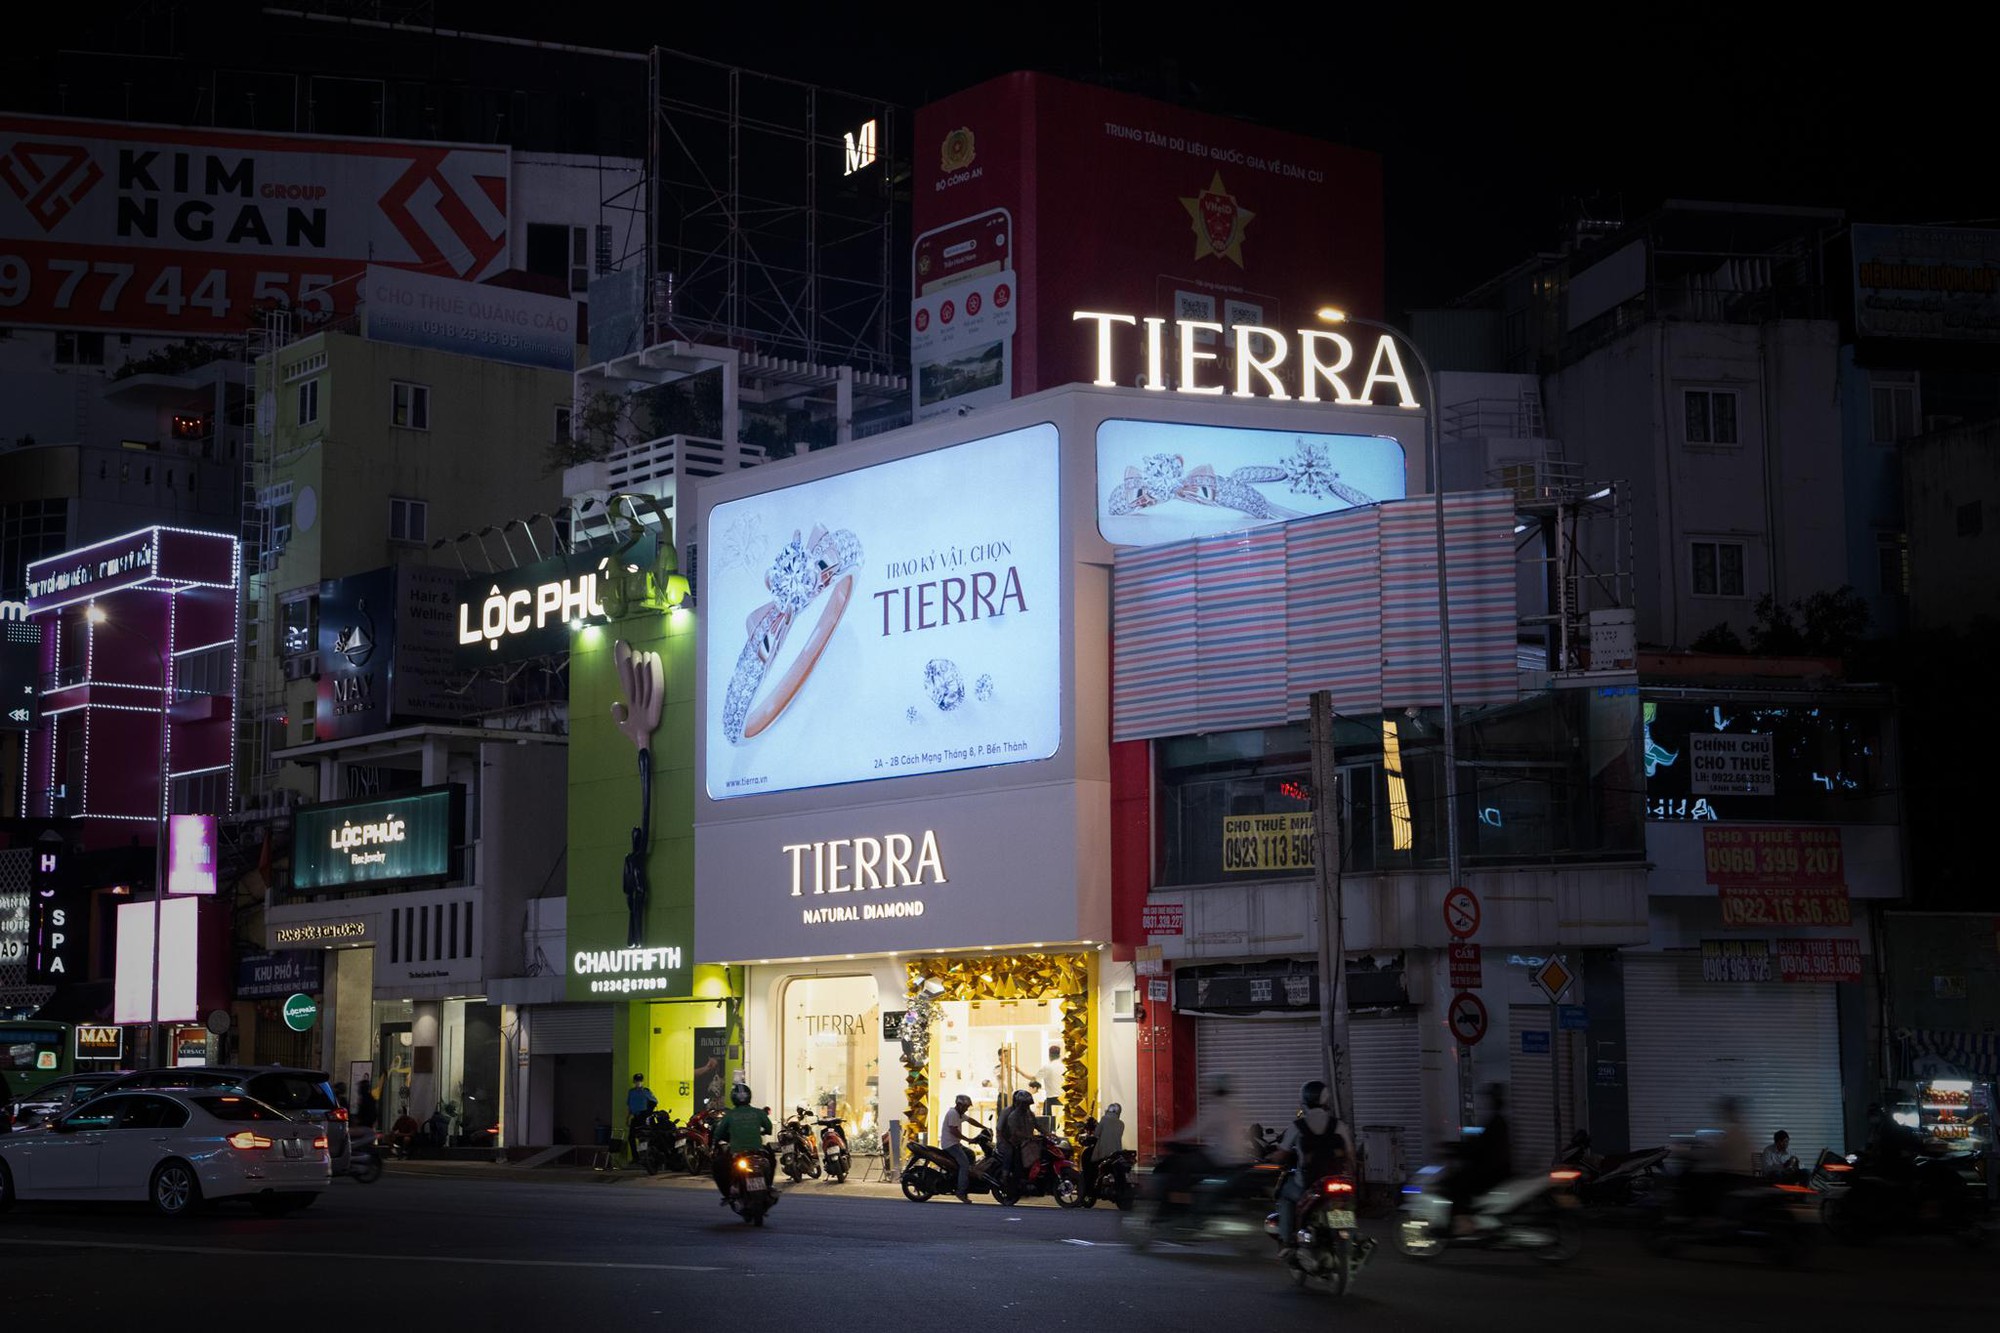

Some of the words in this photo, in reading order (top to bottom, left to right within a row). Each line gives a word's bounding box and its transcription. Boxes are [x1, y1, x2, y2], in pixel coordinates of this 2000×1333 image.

[1105, 122, 1142, 141] TRUNG
[1210, 146, 1244, 164] QUỐC
[1247, 155, 1266, 171] GIA
[119, 149, 254, 198] KIM
[971, 167, 984, 178] AN
[260, 183, 326, 200] GROUP
[117, 197, 327, 248] NGAN
[48, 258, 136, 313] 77
[145, 265, 232, 319] 44
[376, 286, 414, 306] CHO
[418, 293, 464, 315] THUÊ
[1073, 311, 1420, 408] TIERRA
[886, 558, 917, 579] TRAO
[971, 540, 1011, 562] CHỌN
[410, 589, 438, 603] Hair
[441, 592, 451, 604] &
[873, 566, 1029, 636] TIERRA
[459, 584, 531, 651] LỘC
[334, 673, 375, 702] MAY
[1694, 737, 1736, 752] CHÍNH
[1695, 756, 1725, 769] CHO
[1730, 754, 1771, 771] THUÊ
[1226, 820, 1251, 833] CHO
[1255, 816, 1286, 831] THUÊ
[1705, 831, 1742, 843] CHO
[1750, 828, 1793, 843] THUÊ
[783, 830, 948, 896] TIERRA
[1226, 836, 1258, 868] 0923
[1263, 835, 1288, 867] 113
[1707, 846, 1756, 873] 0969
[803, 906, 860, 924] NATURAL
[863, 901, 925, 920] DIAMOND
[1722, 898, 1850, 924] 0922.16.36.36
[1778, 942, 1802, 954] CHO
[1805, 939, 1833, 954] THUÊ
[255, 966, 272, 981] KHU
[274, 958, 292, 979] PHỐ
[294, 964, 300, 978] 4
[80, 1029, 118, 1042] MAY
[805, 1014, 866, 1036] TIERRA
